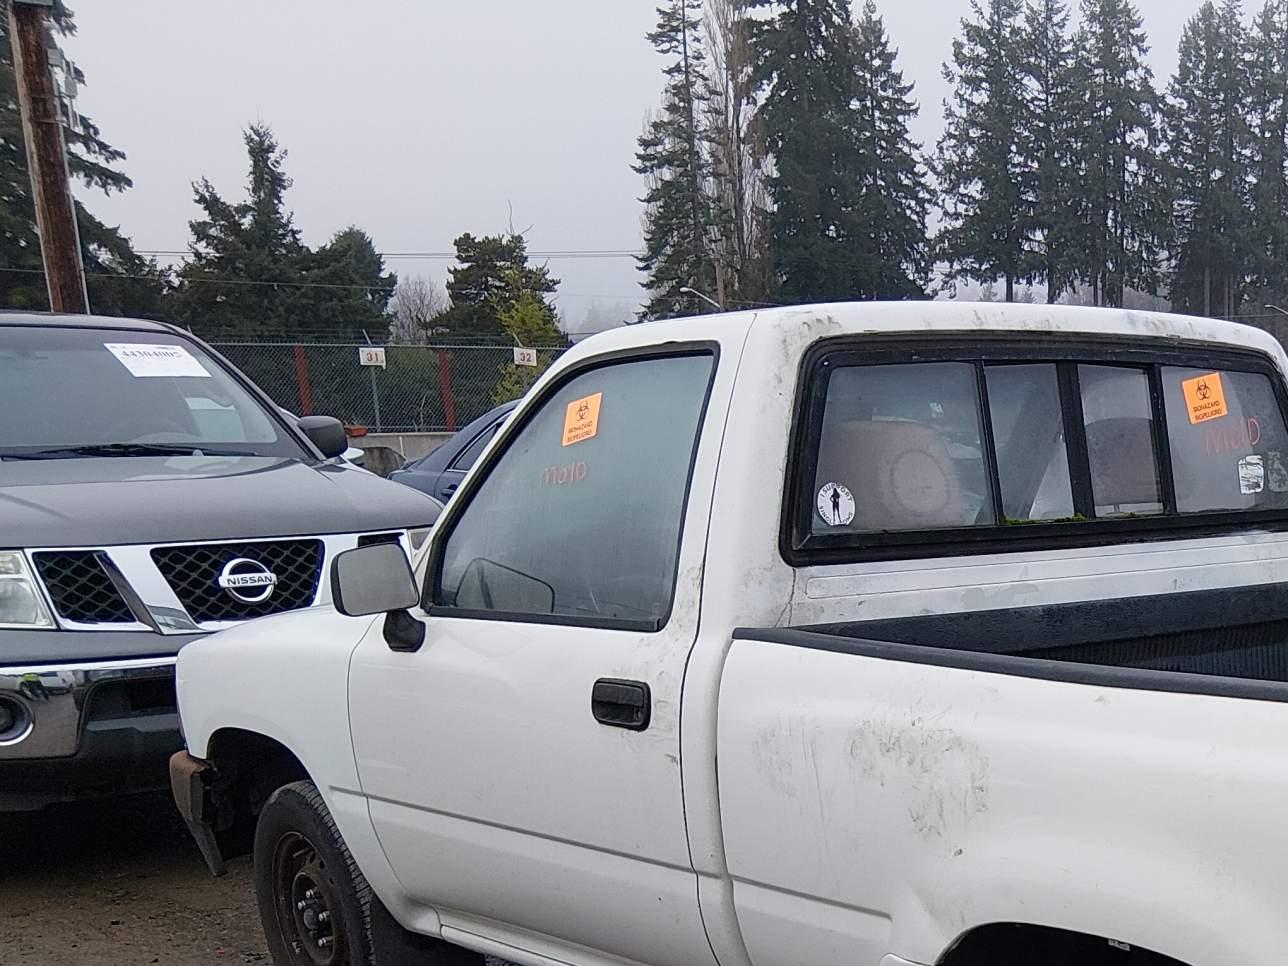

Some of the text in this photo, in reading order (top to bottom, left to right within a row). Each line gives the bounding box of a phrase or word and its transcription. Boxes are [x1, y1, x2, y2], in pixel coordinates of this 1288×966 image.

[519, 352, 532, 363] 32
[1193, 401, 1220, 413] BIOHAZARD
[227, 576, 272, 585] NISSAN
